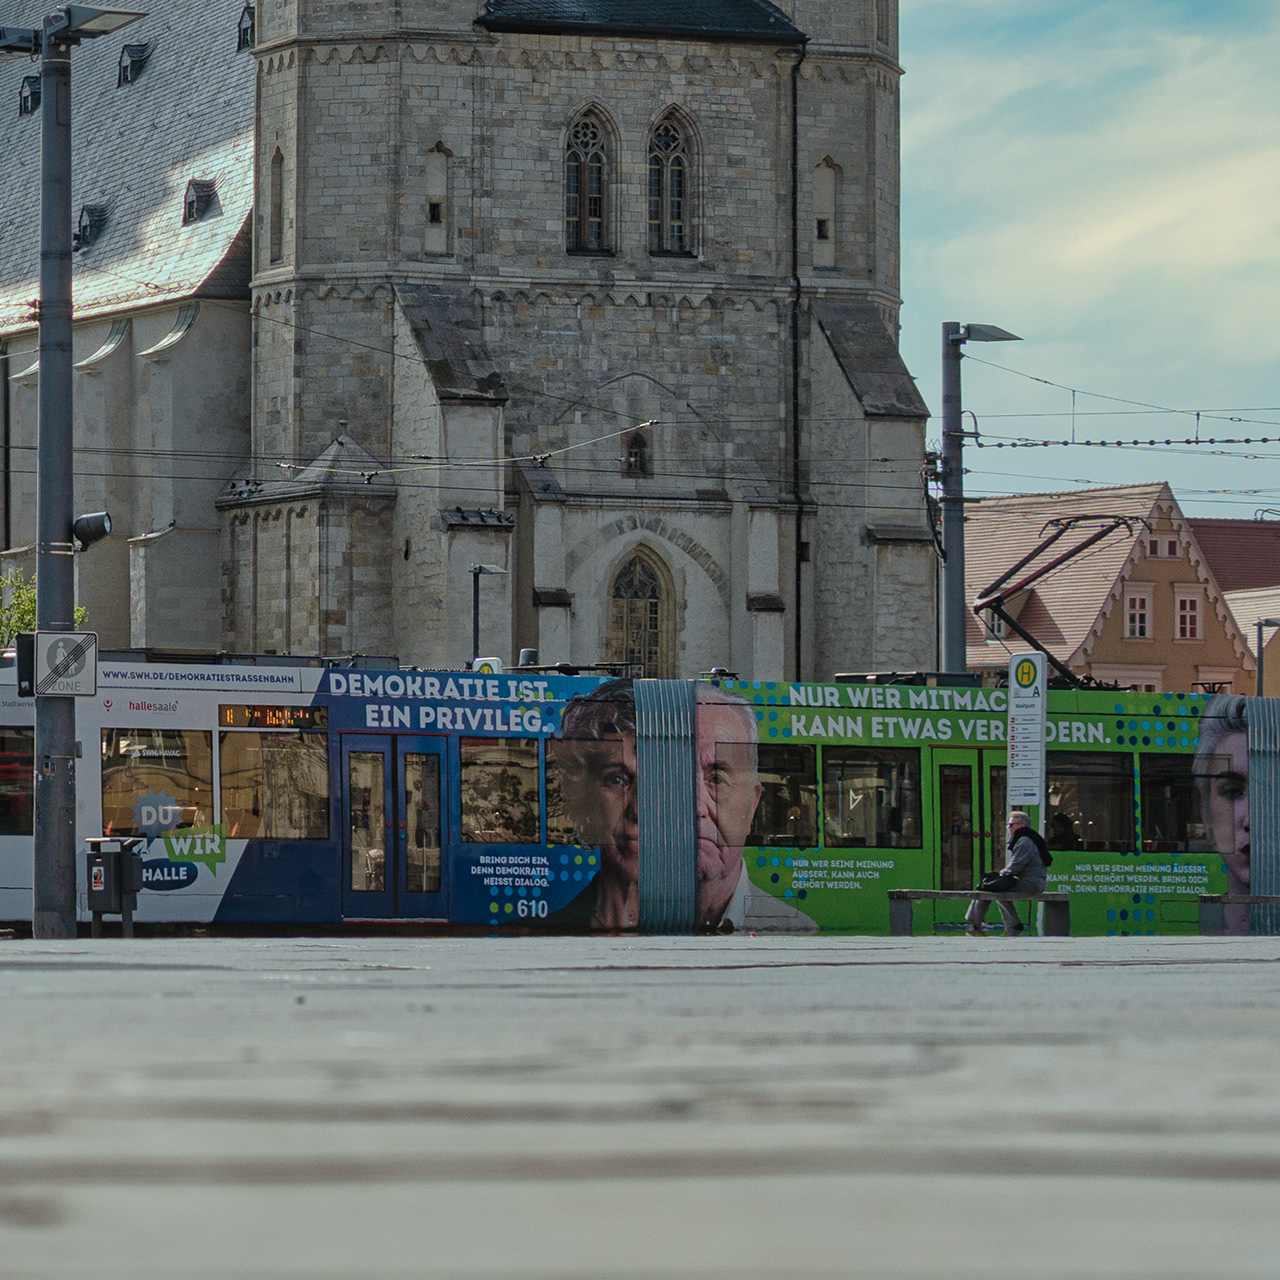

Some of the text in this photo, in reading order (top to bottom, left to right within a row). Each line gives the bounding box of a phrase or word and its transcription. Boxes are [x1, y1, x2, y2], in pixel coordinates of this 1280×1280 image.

[102, 670, 294, 684] WWW.SWH.DE/DEMOKRATIESTRASSENBAHN
[51, 681, 81, 692] ZONE
[329, 672, 548, 703] DEMOKRATIE IST
[1033, 686, 1040, 697] A
[789, 685, 840, 707] NUR
[846, 686, 902, 709] WER
[366, 704, 548, 732] EIN PRIVILEG.
[791, 715, 863, 738] KANN
[872, 716, 952, 740] ETWAS
[142, 749, 158, 757] SWH.
[141, 805, 173, 826] DU
[170, 833, 221, 856] WIR
[479, 855, 549, 865] BRING DICH EIN,
[792, 860, 894, 869] NUR WER SEINE MEINUNG
[471, 866, 549, 875] DENN DEMOKRATIE
[1093, 864, 1109, 872] WER
[142, 867, 187, 882] HALLE
[856, 871, 880, 879] AUCH
[1047, 873, 1208, 883] KANN AUCH GEHÖRT WERDEN. BRING DICH
[484, 877, 549, 887] HEISST DIALOG.
[791, 879, 862, 889] GEHÖRT WERDEN.
[1076, 885, 1097, 893] DENN
[1099, 885, 1147, 893] DEMOKRATIE
[1149, 885, 1176, 893] HEISST
[1177, 886, 1208, 894] DIALOG.
[517, 899, 548, 918] 610
